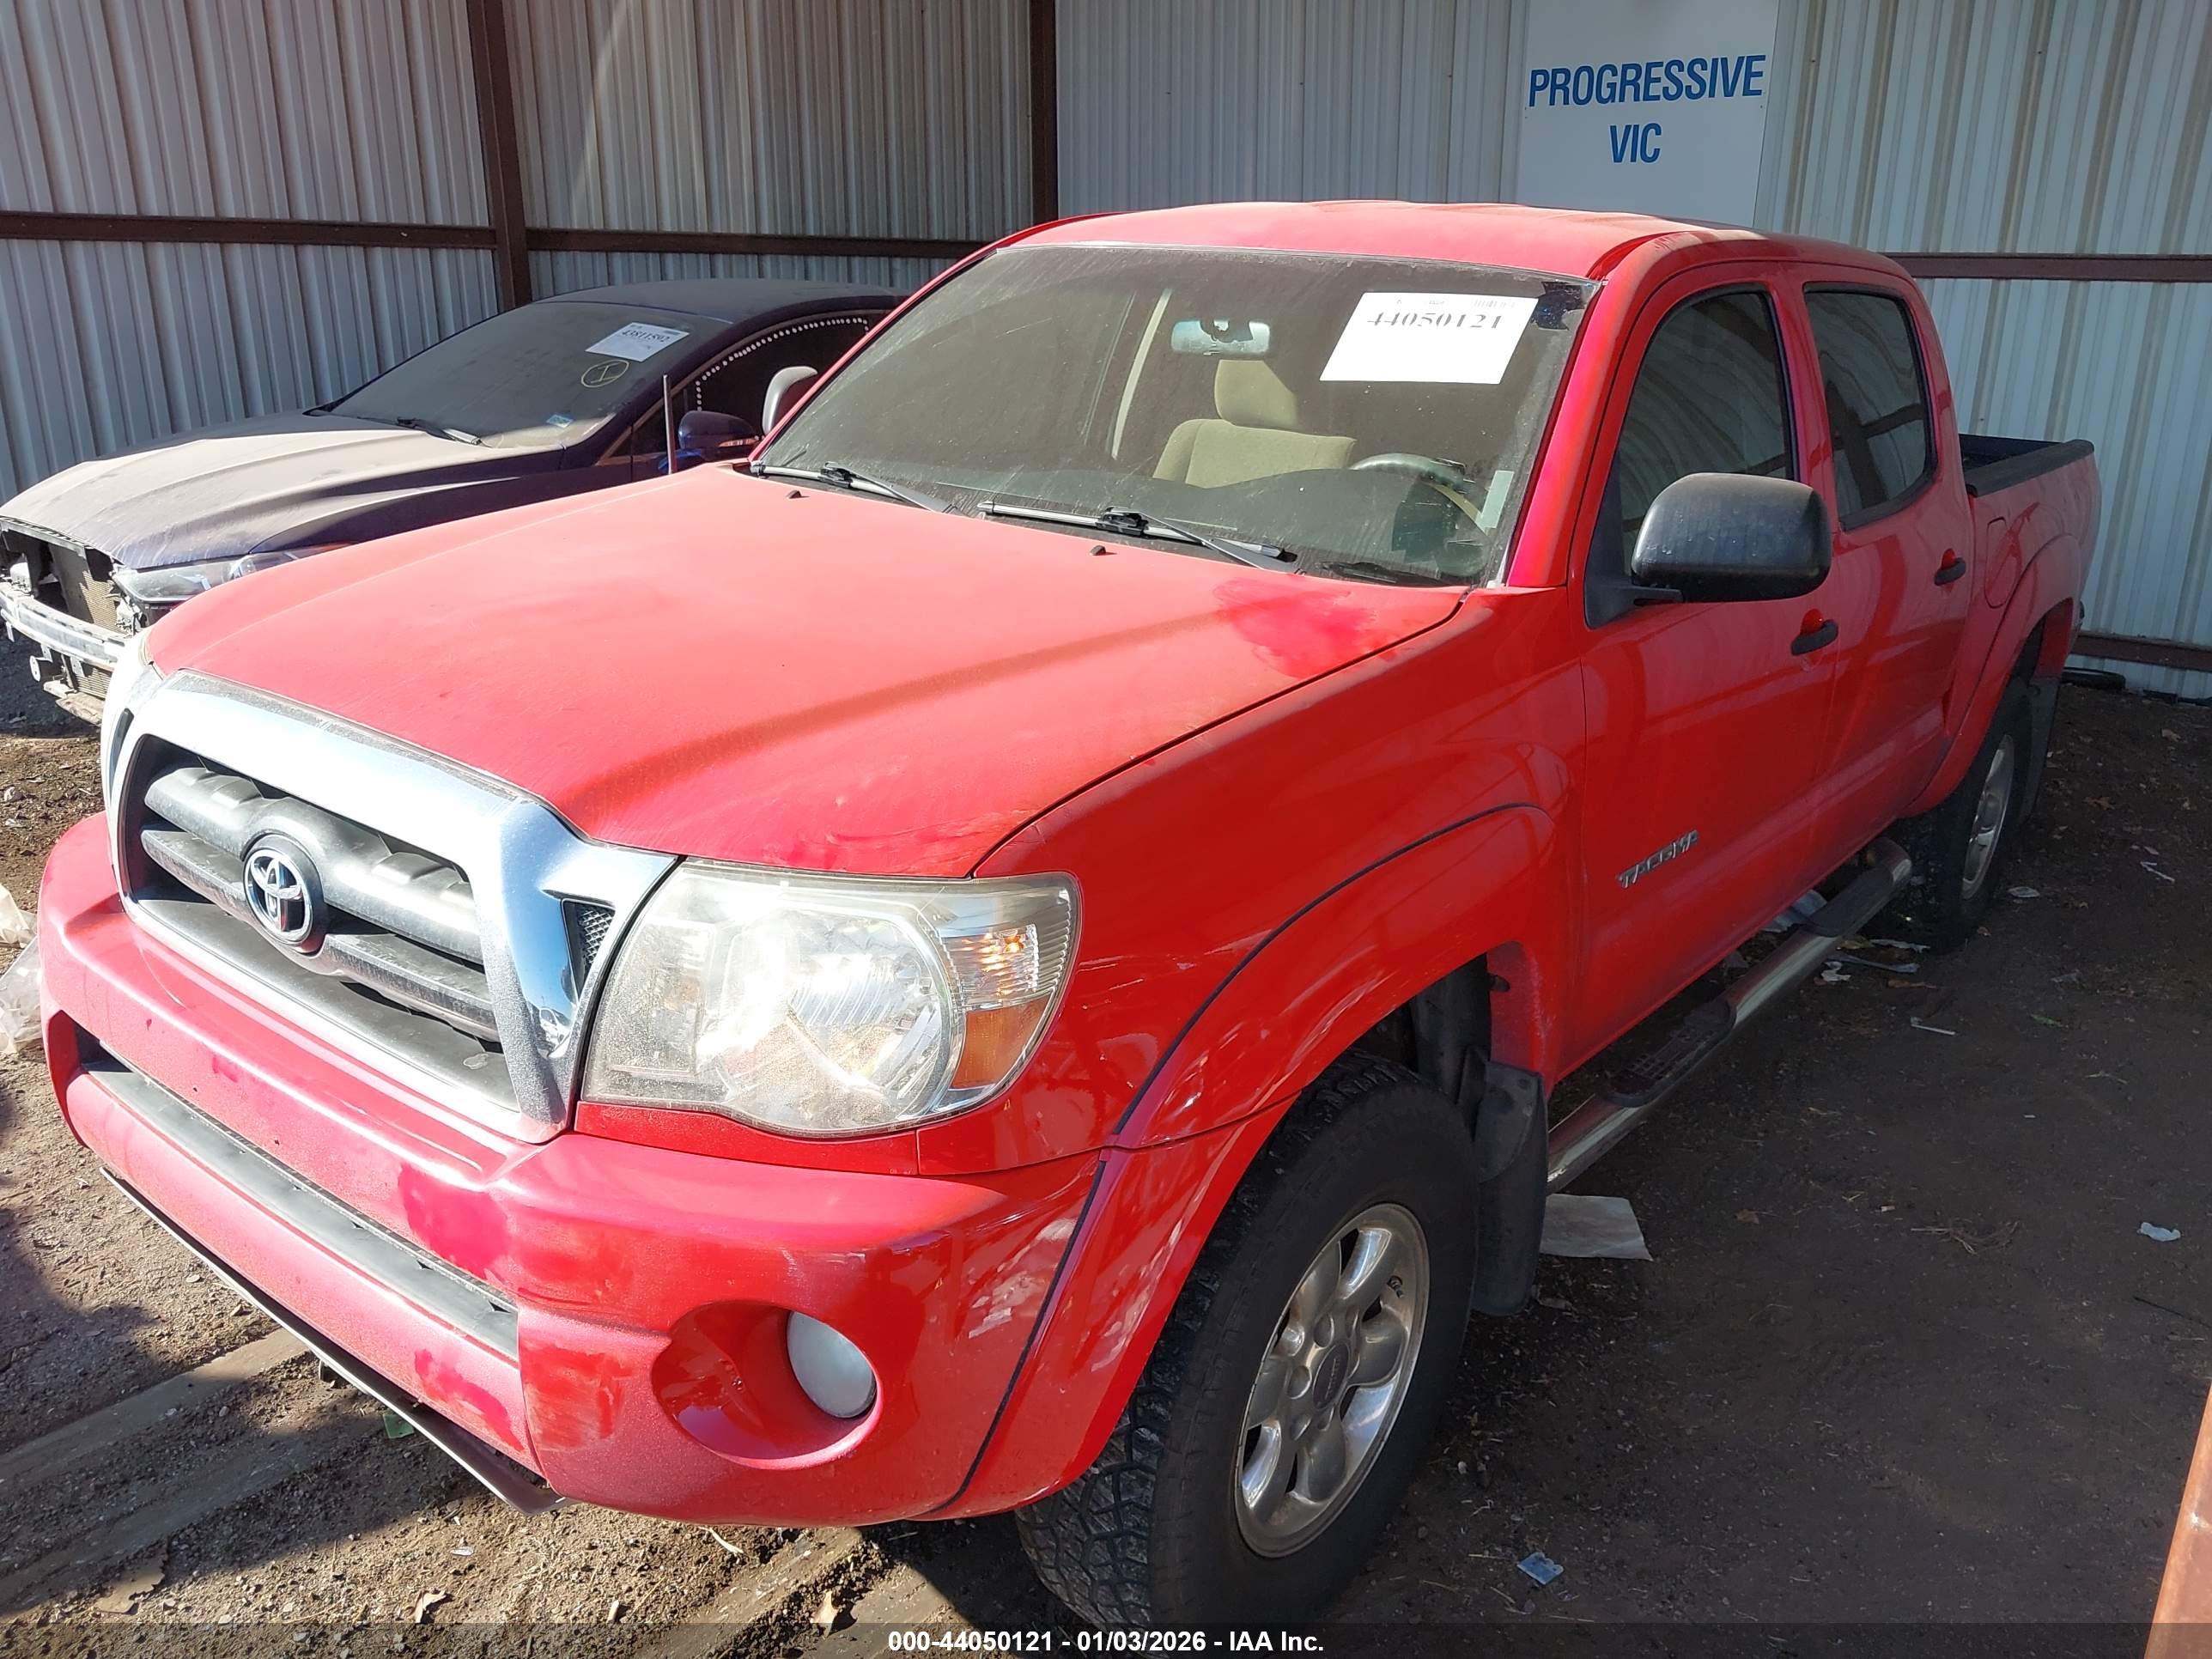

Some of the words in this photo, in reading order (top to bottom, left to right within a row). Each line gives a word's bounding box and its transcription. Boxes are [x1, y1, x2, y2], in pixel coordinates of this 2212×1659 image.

[1528, 54, 1766, 107] PROGRESSIVE
[1609, 123, 1662, 163] VIC
[1367, 312, 1502, 329] 44050121
[1615, 830, 1698, 889] TACOMA
